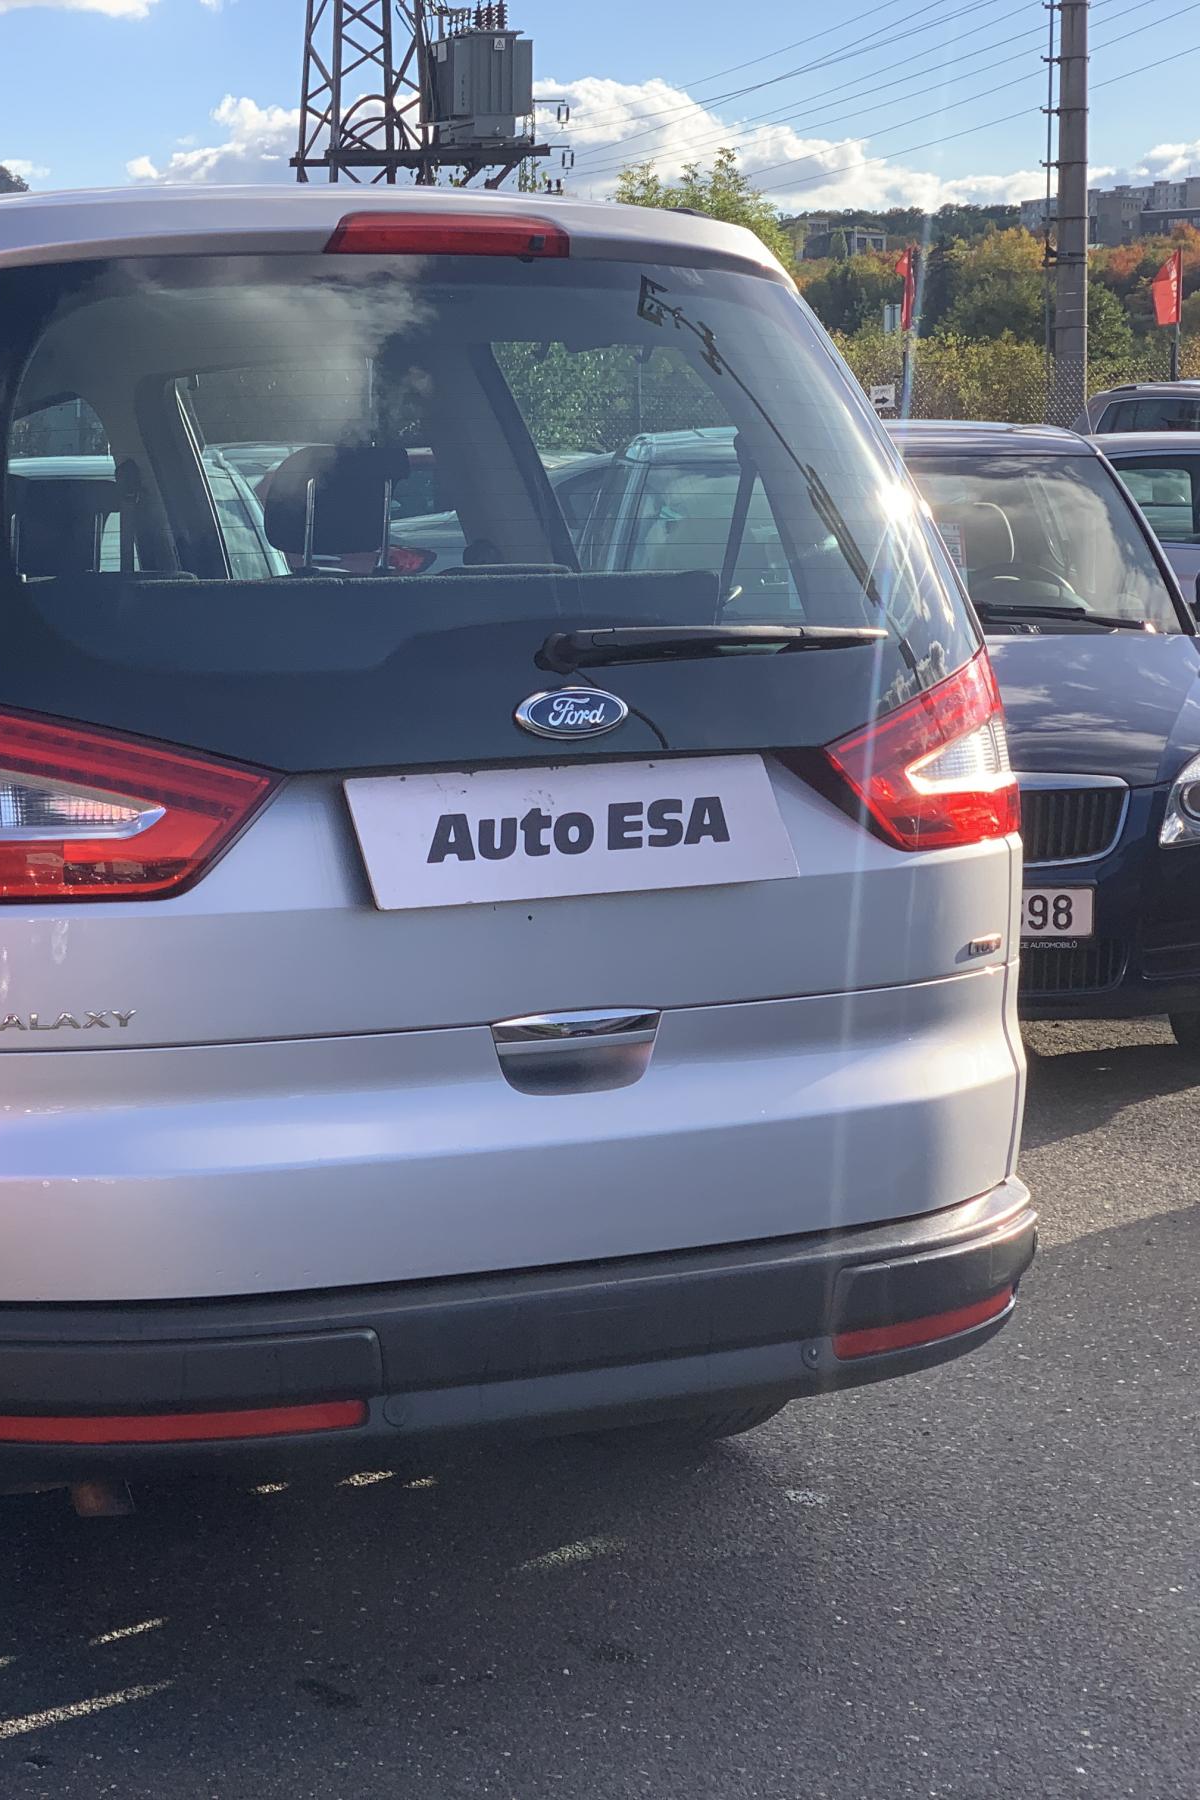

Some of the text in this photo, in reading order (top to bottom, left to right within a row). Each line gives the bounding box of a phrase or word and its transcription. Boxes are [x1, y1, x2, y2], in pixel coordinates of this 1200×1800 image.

[548, 697, 605, 726] Ford
[426, 796, 731, 864] Auto ESA
[1020, 894, 1073, 931] 98
